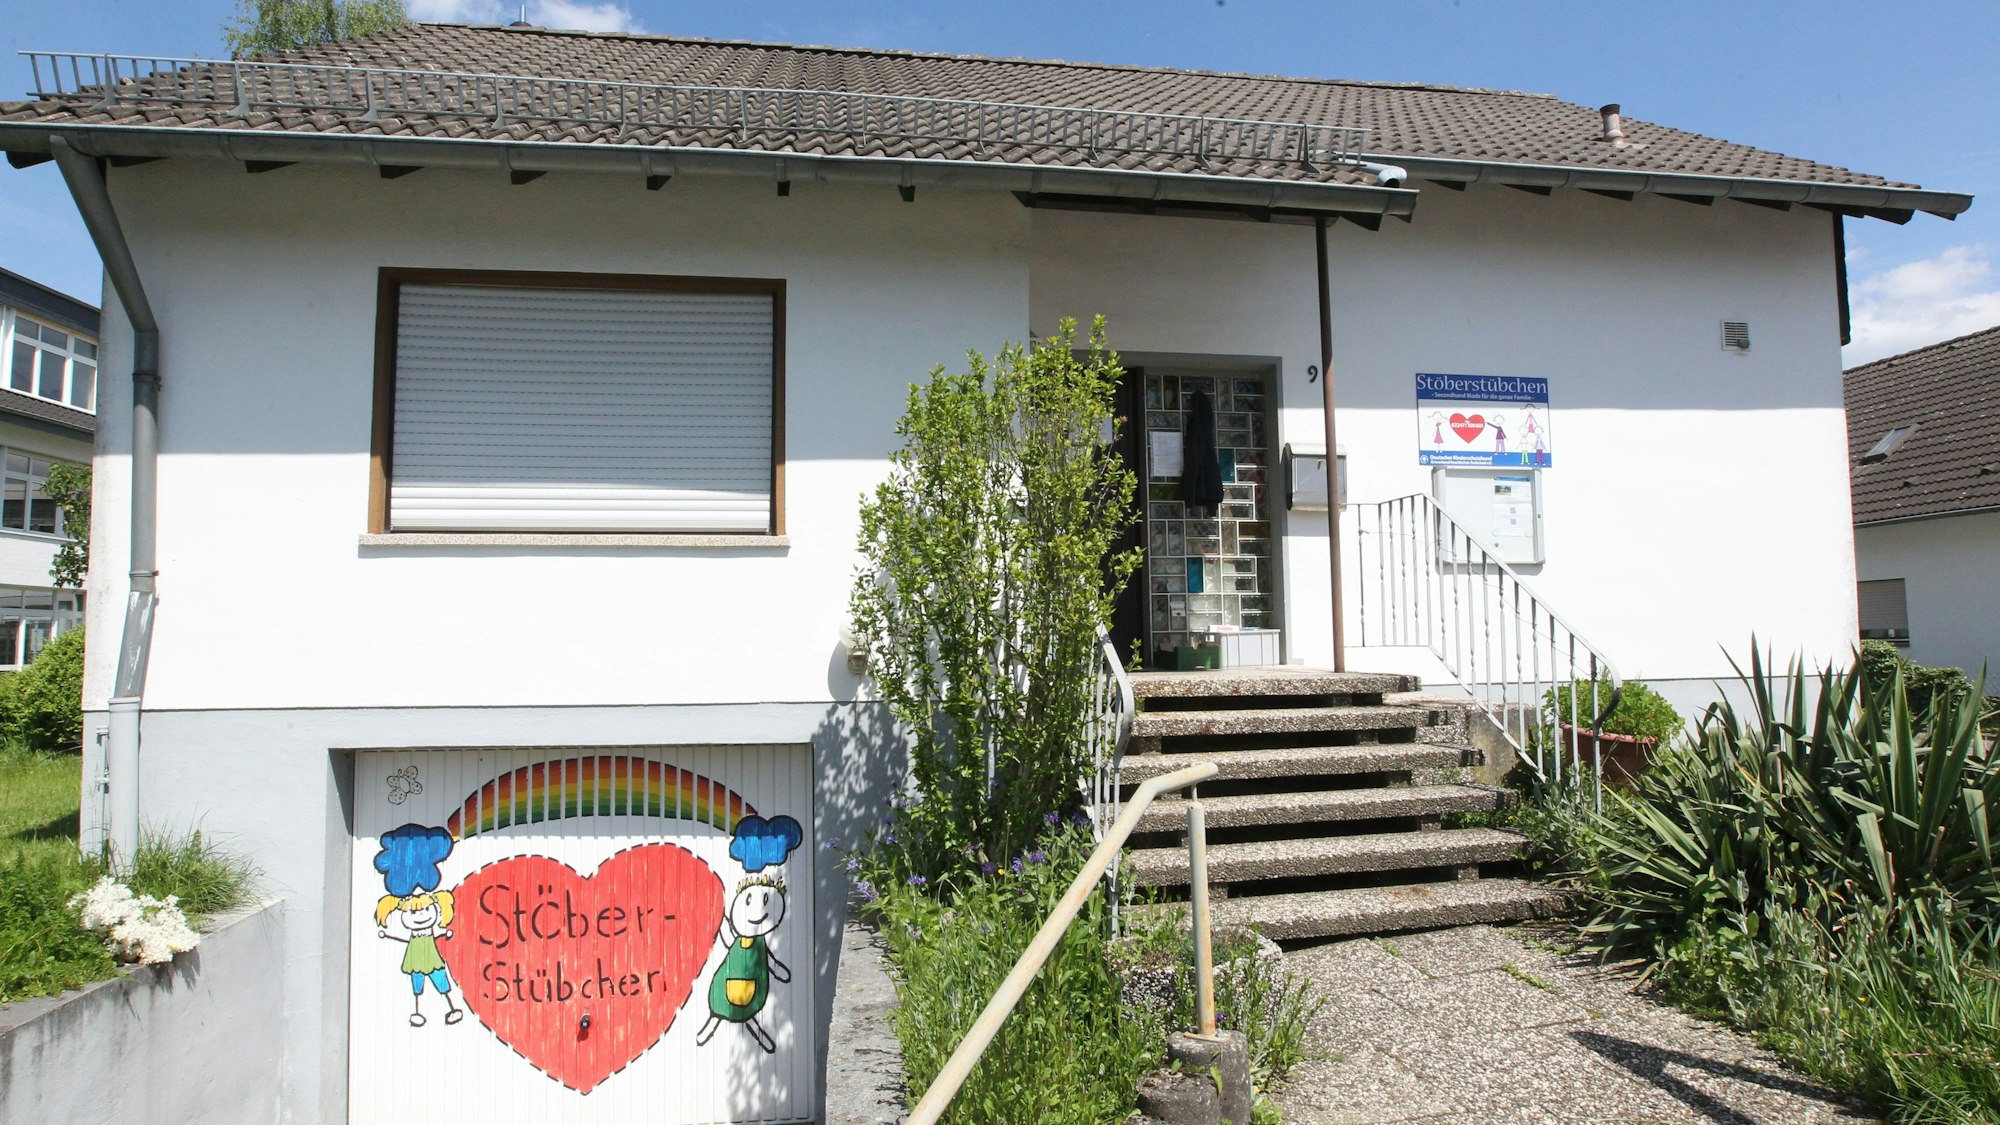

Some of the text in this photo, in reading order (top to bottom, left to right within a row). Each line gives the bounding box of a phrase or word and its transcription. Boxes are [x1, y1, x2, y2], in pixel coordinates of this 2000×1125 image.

[1307, 365, 1318, 383] 9
[1416, 374, 1547, 393] Stöberstübchen
[483, 959, 667, 1003] Stübchen
